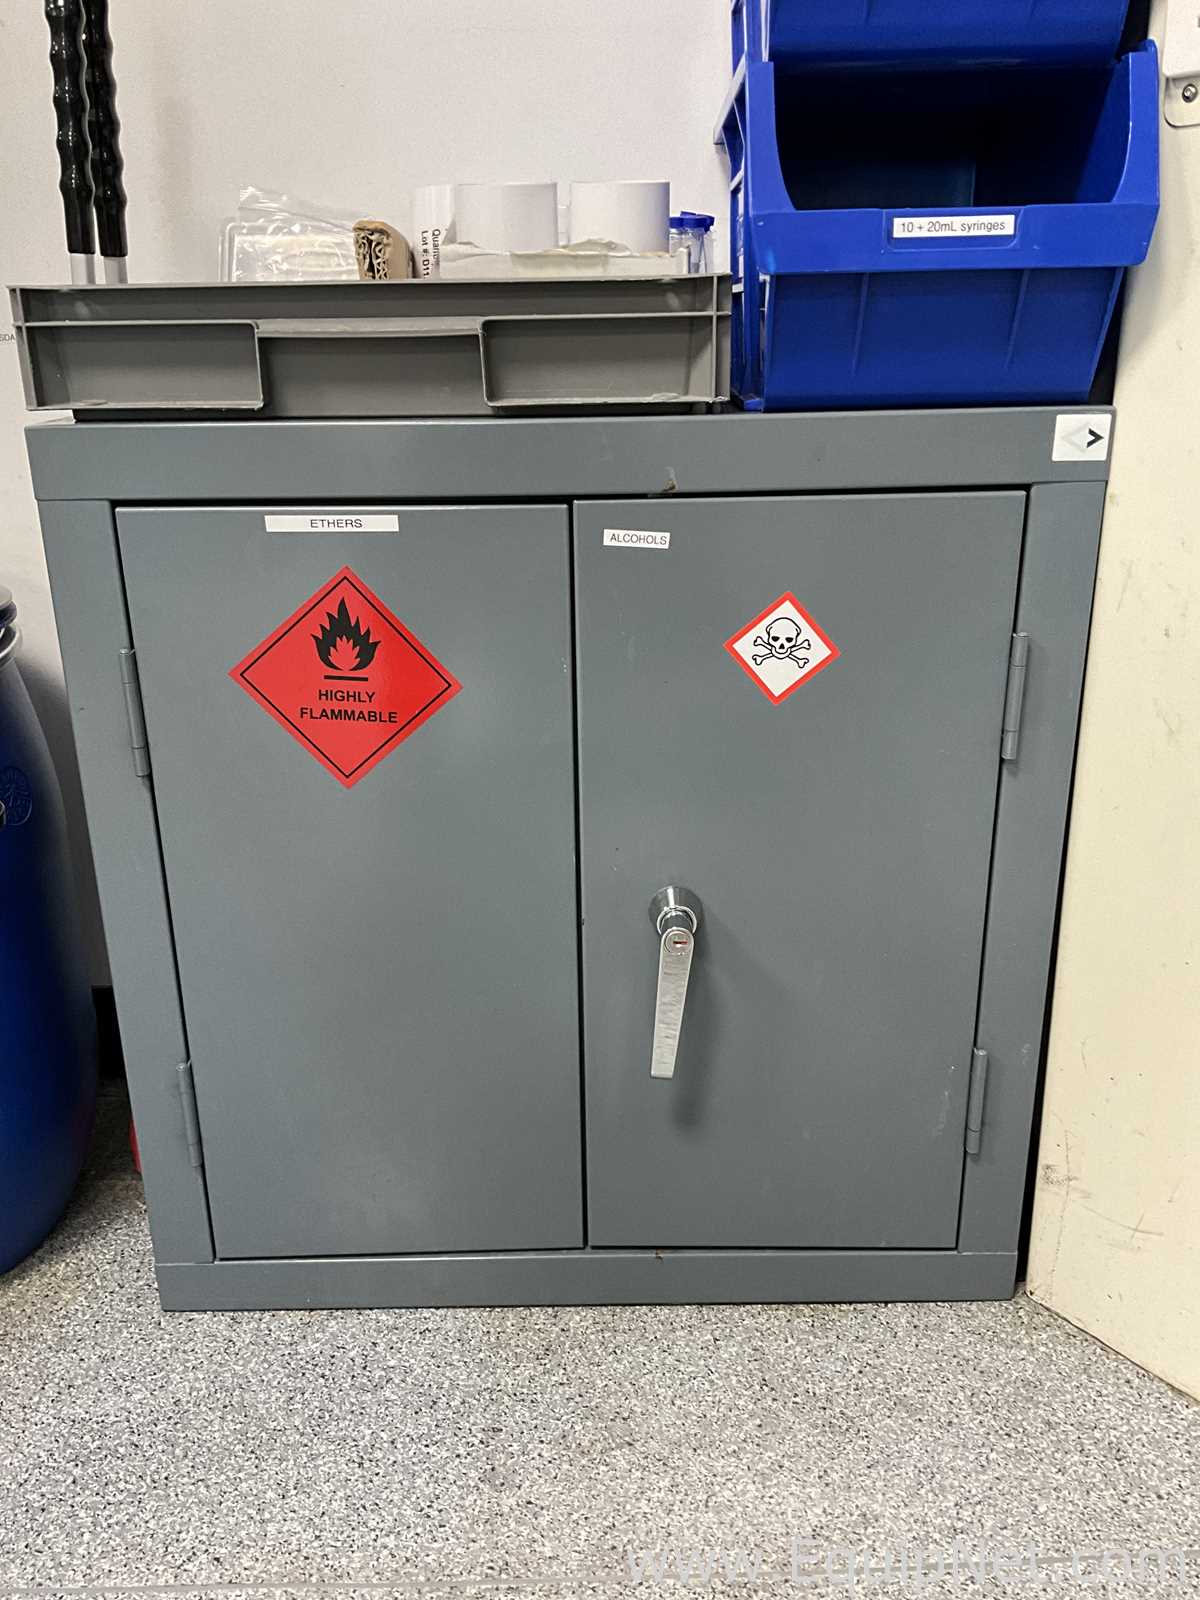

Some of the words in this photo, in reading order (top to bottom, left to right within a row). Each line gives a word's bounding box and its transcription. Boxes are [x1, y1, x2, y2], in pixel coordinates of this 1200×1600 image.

[901, 222, 914, 233] 10
[927, 221, 957, 233] 20mL
[960, 219, 1006, 232] syringes
[421, 230, 429, 246] Lot
[310, 518, 363, 528] ETHERS
[610, 533, 667, 546] ALCOHOLS
[318, 689, 376, 703] HIGHLY
[300, 707, 398, 723] FLAMMABLE
